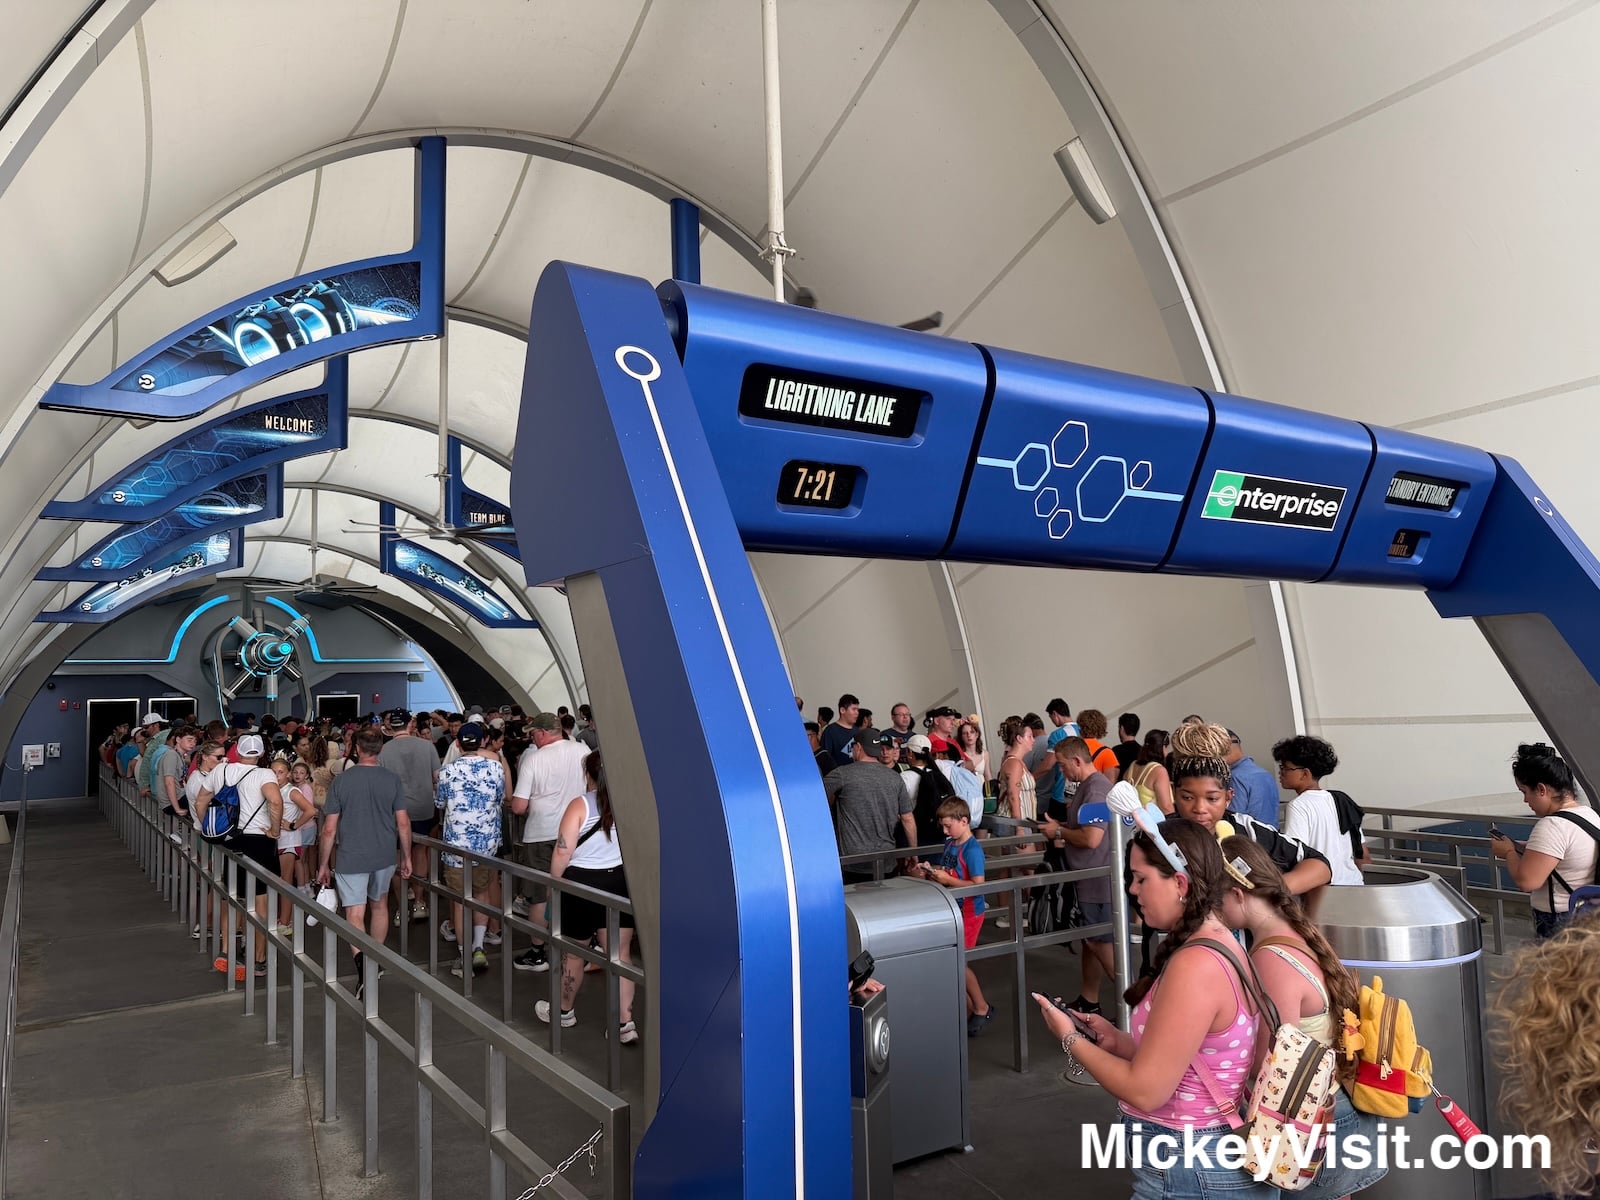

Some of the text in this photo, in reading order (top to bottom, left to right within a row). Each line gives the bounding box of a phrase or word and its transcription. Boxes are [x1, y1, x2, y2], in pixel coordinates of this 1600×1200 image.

[765, 378, 897, 426] LIGHTNING LANE
[265, 415, 314, 433] WELCOME
[794, 467, 836, 501] 7:21
[1415, 483, 1456, 507] ENTRANCE
[1214, 485, 1339, 519] enterprise
[470, 512, 506, 525] TEAM BLUE
